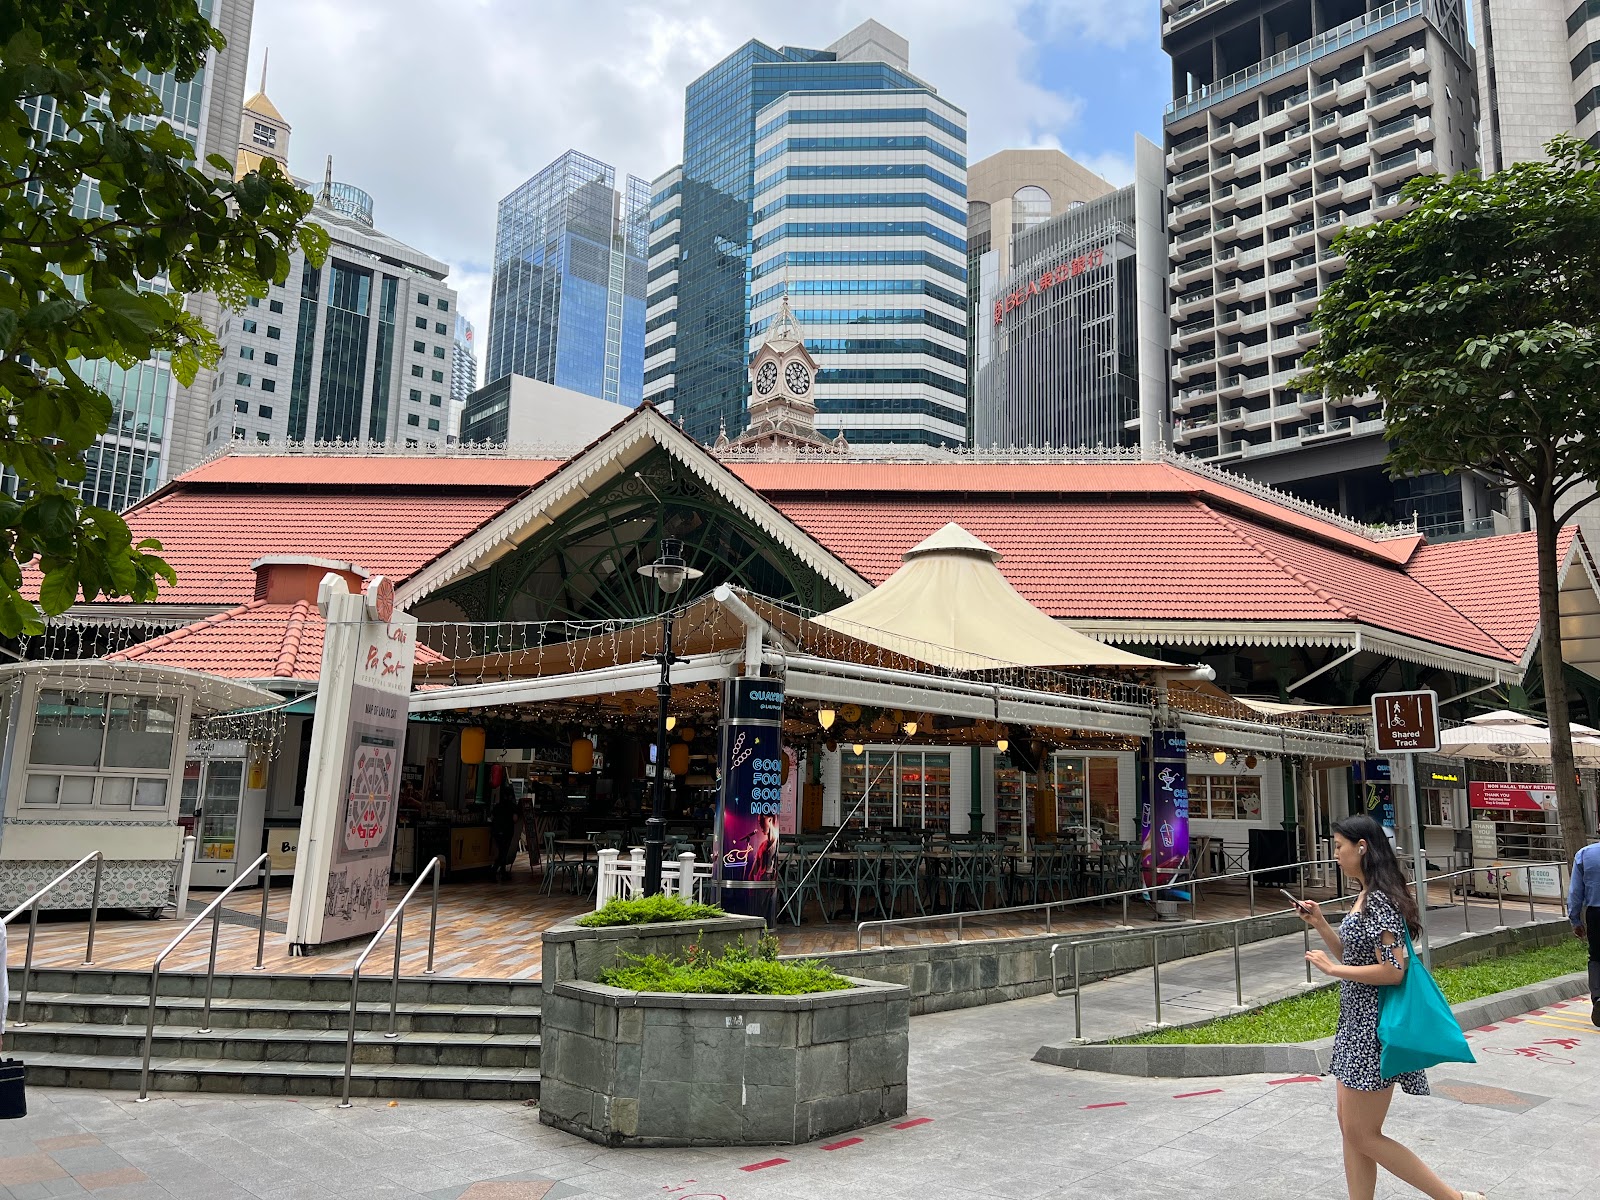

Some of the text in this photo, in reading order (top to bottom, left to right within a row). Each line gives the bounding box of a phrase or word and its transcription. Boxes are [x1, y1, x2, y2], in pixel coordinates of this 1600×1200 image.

[1005, 248, 1104, 313] BEA 東亞銀行
[365, 645, 406, 676] Pa Sat
